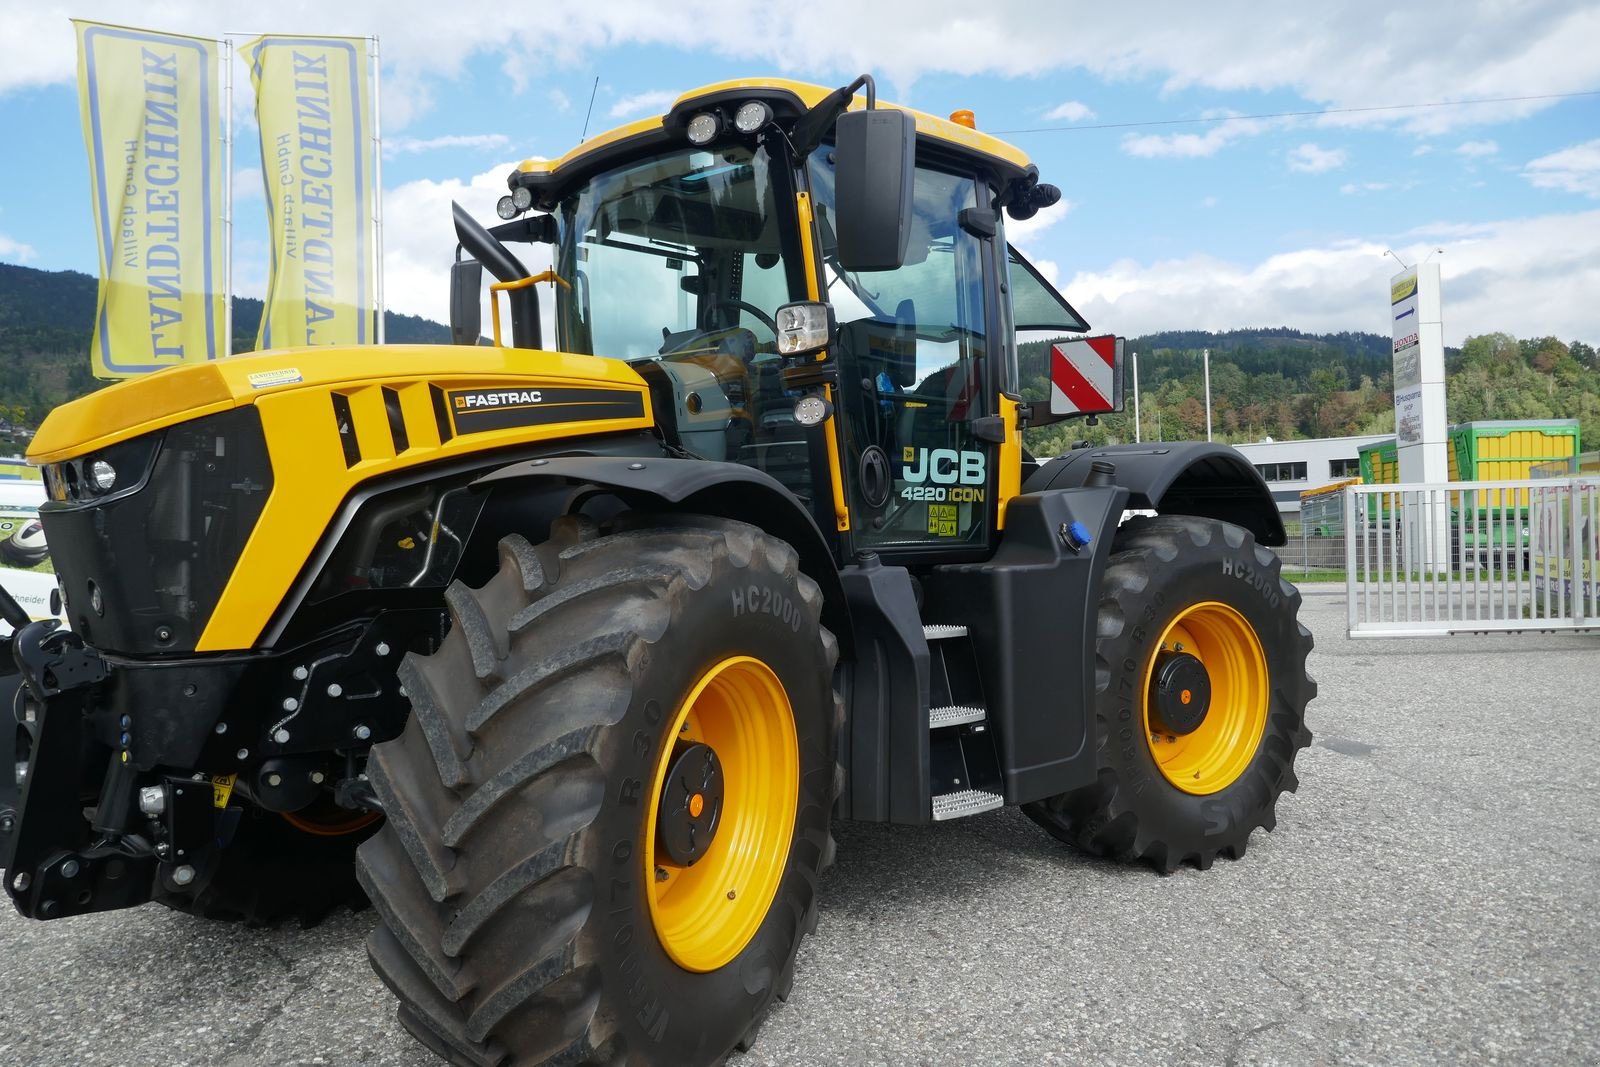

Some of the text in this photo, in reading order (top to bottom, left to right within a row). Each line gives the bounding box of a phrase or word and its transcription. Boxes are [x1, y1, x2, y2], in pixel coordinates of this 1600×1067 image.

[1394, 332, 1419, 349] HONDA
[465, 391, 542, 407] FASTRAC
[902, 447, 986, 485] JCB
[901, 486, 985, 502] 4220 iCON
[1221, 556, 1280, 609] HC2000
[12, 594, 45, 605] hneider
[731, 584, 801, 632] HC2000
